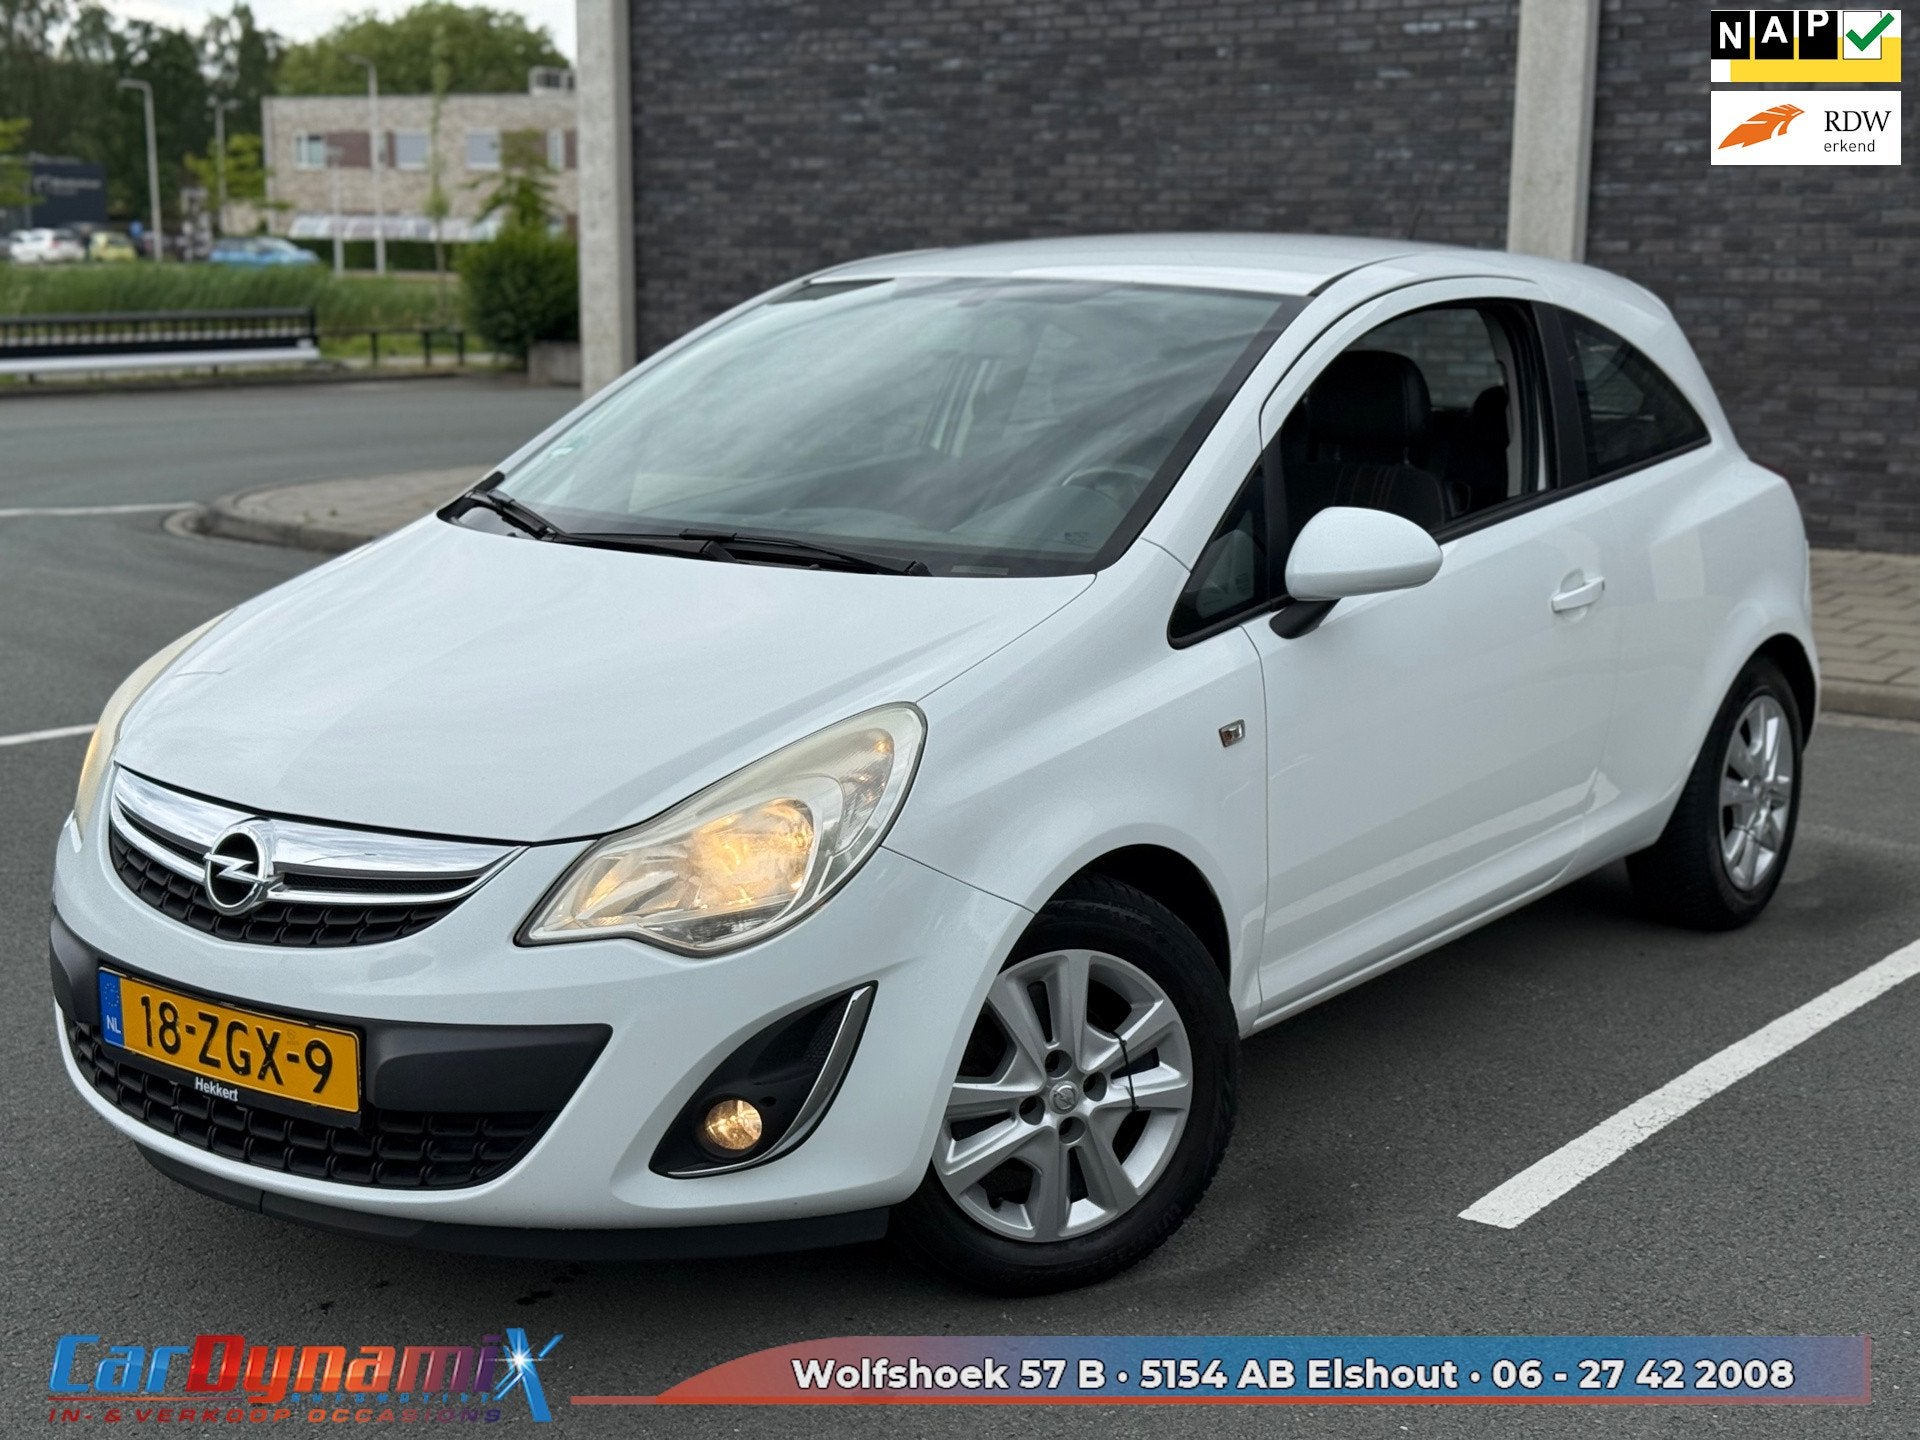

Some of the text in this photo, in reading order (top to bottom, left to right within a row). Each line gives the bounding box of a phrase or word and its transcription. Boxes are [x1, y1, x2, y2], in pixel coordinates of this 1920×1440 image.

[106, 1014, 121, 1034] NL
[140, 995, 334, 1094] 18-ZGX-9
[194, 1076, 239, 1102] Hekkert
